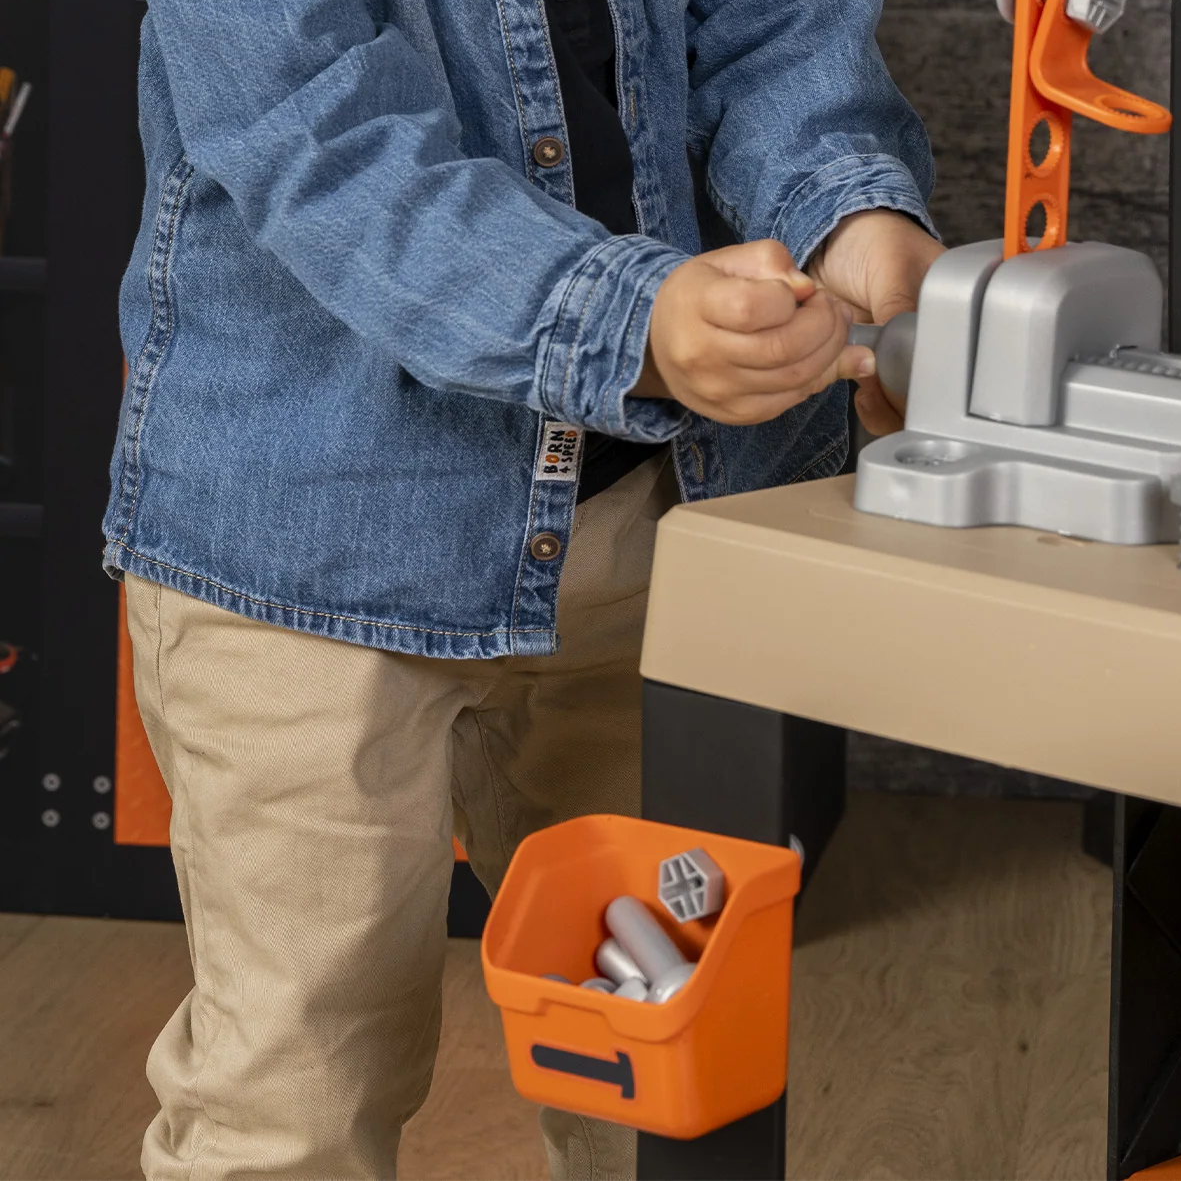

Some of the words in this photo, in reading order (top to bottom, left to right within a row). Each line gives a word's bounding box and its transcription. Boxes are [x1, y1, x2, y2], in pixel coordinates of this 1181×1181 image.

[543, 430, 566, 473] BORN
[561, 430, 578, 463] SPEED
[559, 465, 571, 474] 4
